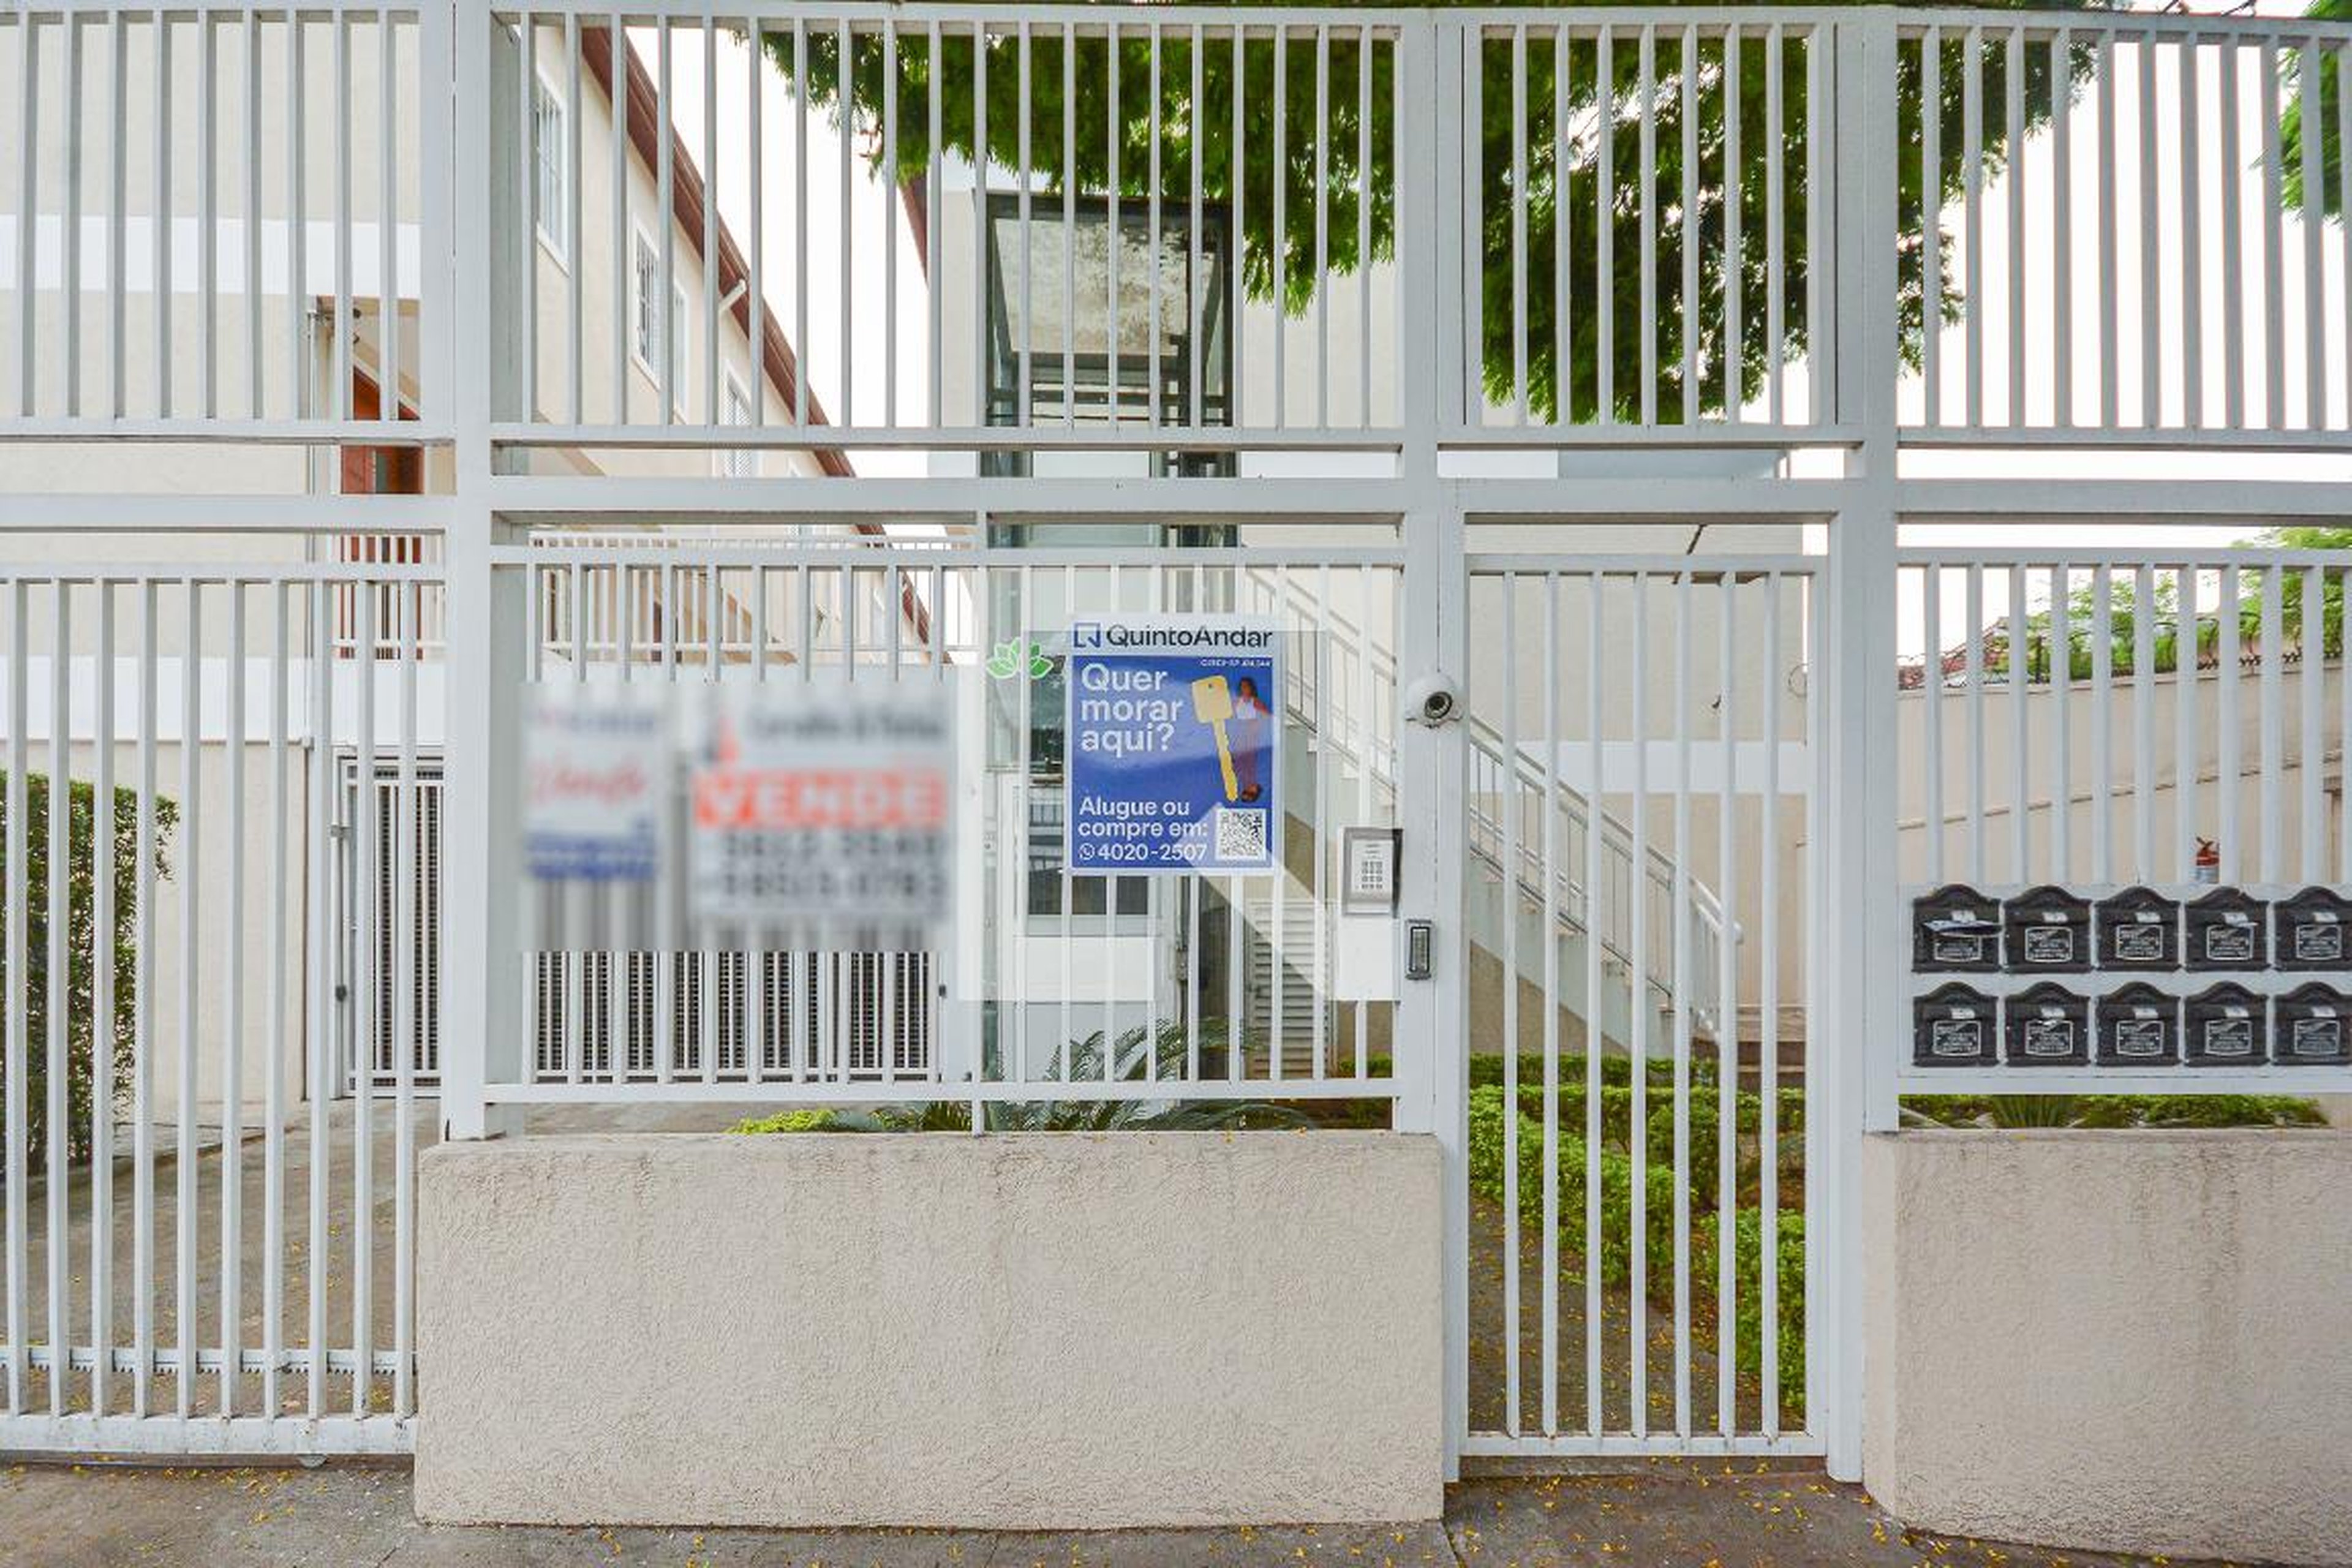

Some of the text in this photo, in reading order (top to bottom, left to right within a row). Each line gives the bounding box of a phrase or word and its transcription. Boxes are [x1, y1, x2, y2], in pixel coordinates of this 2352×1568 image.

[1106, 625, 1273, 648] QuintoAndar
[1081, 663, 1168, 692] Quer
[1081, 698, 1184, 722] morar
[1081, 722, 1175, 758] aqui?
[1079, 796, 1190, 821] Alugue ou
[1077, 821, 1208, 841] compre em:
[1098, 843, 1208, 861] 4020-2507
